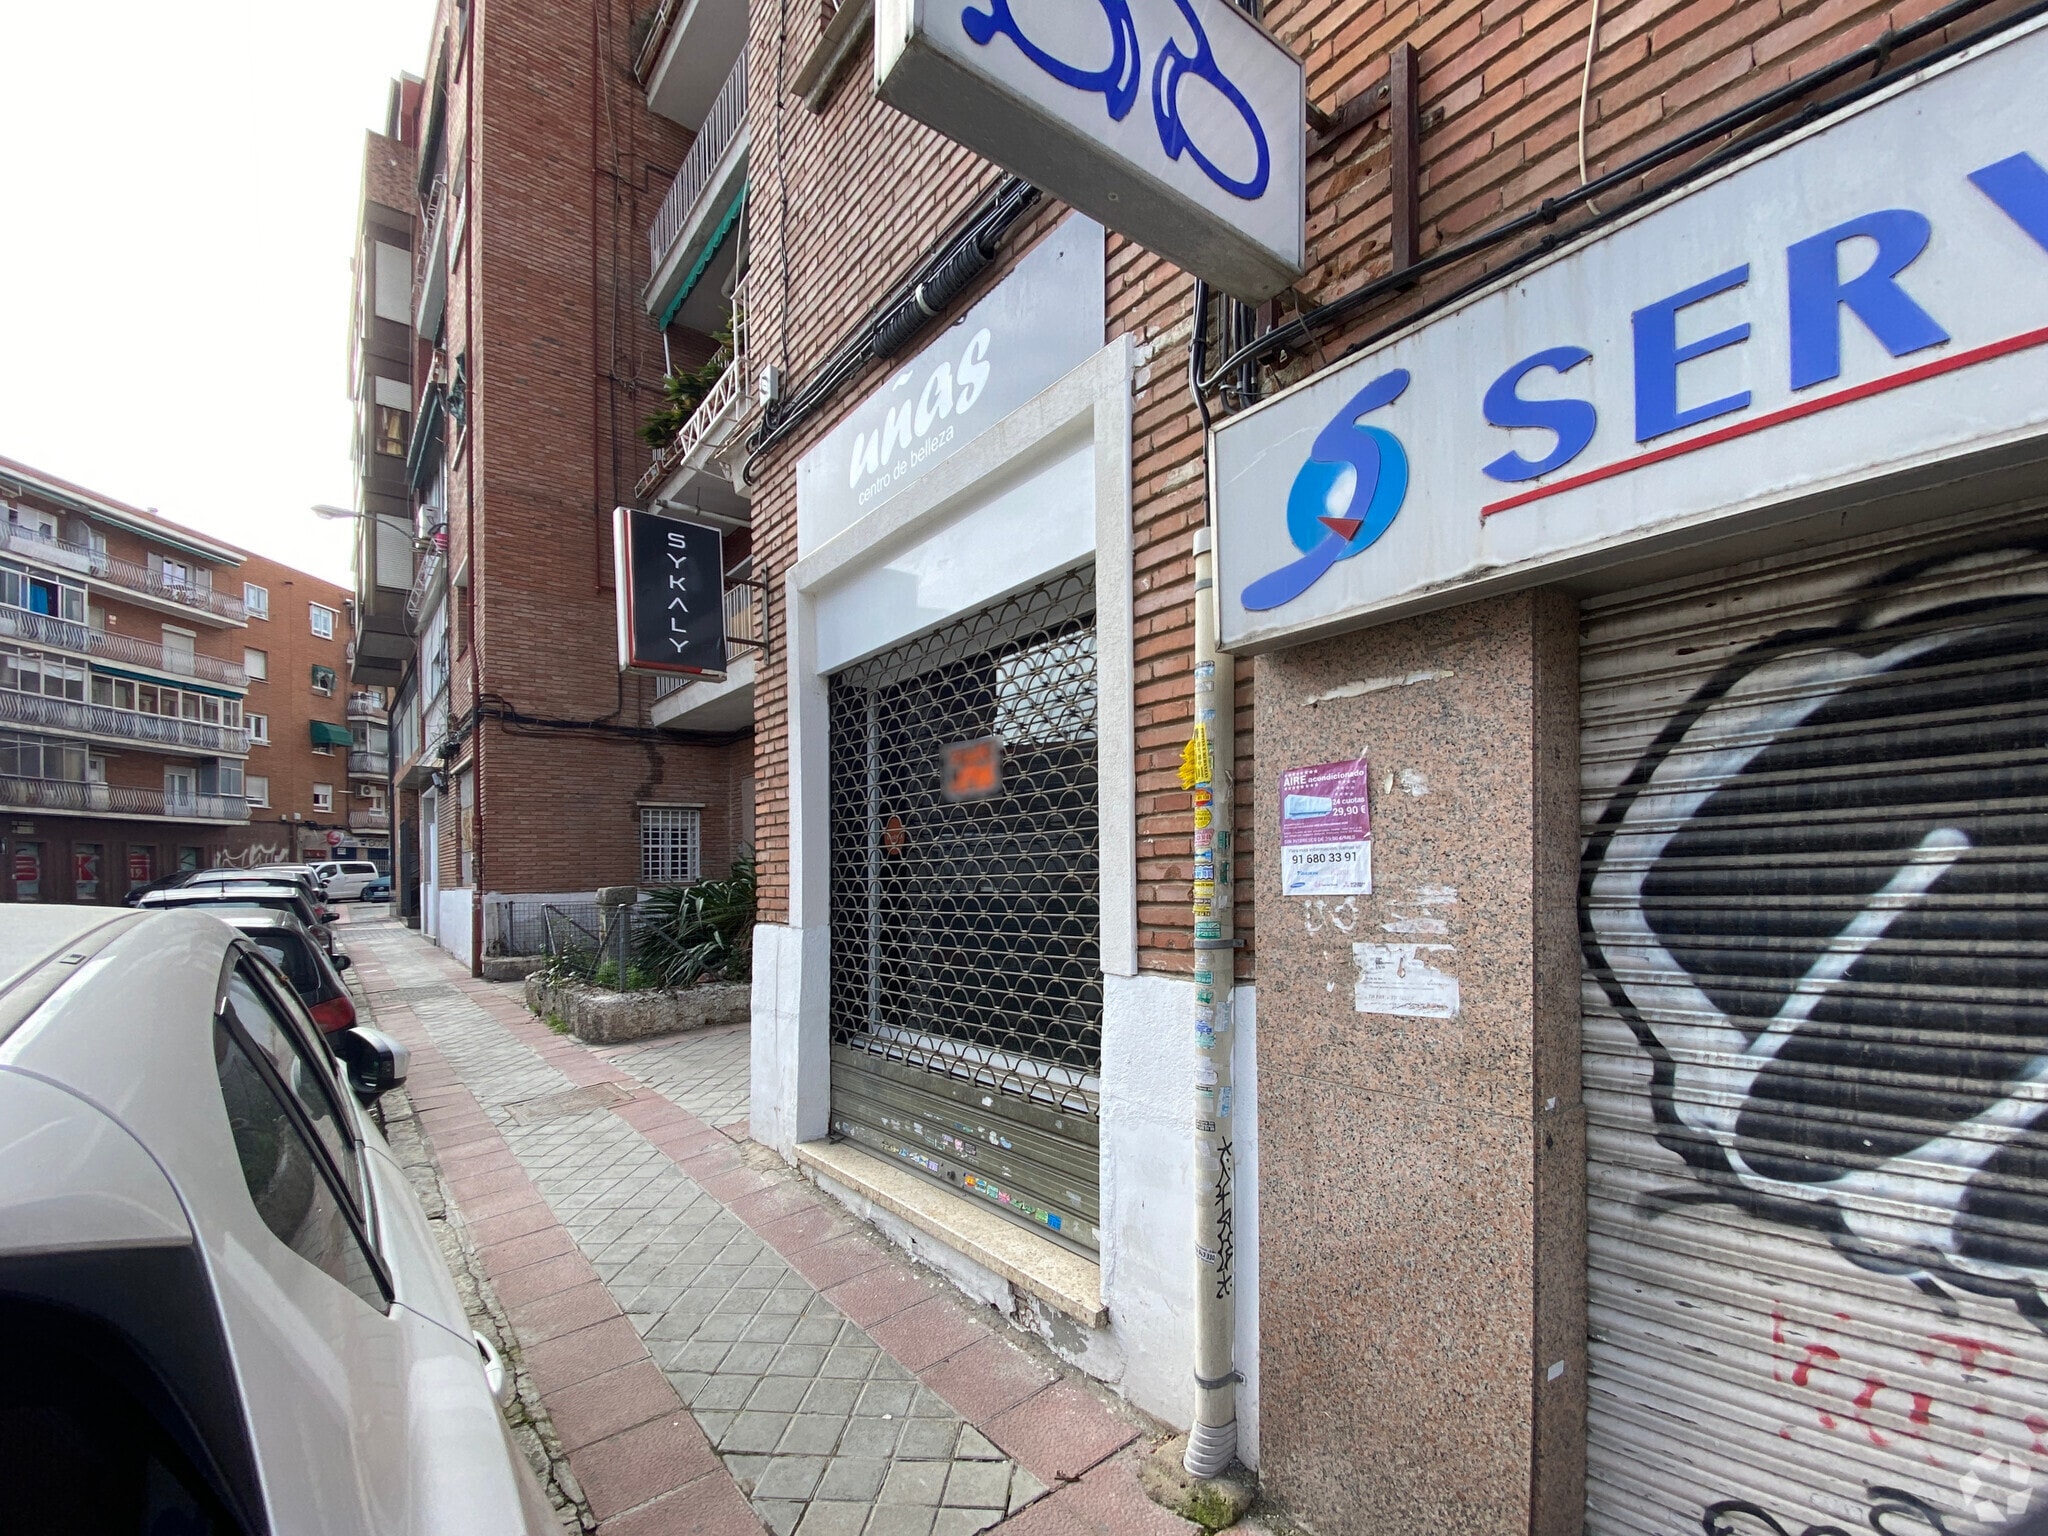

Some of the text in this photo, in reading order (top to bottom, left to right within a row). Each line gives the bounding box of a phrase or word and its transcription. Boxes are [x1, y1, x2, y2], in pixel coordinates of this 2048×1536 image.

[849, 327, 991, 489] uñas
[858, 424, 955, 506] centro de belleza
[666, 531, 690, 654] SYKALY
[1283, 769, 1365, 788] AIRE acondicionado
[1332, 796, 1365, 807] 24 cuotas
[1332, 804, 1367, 817] 29,90 €
[1291, 851, 1358, 865] 91 680 33 91
